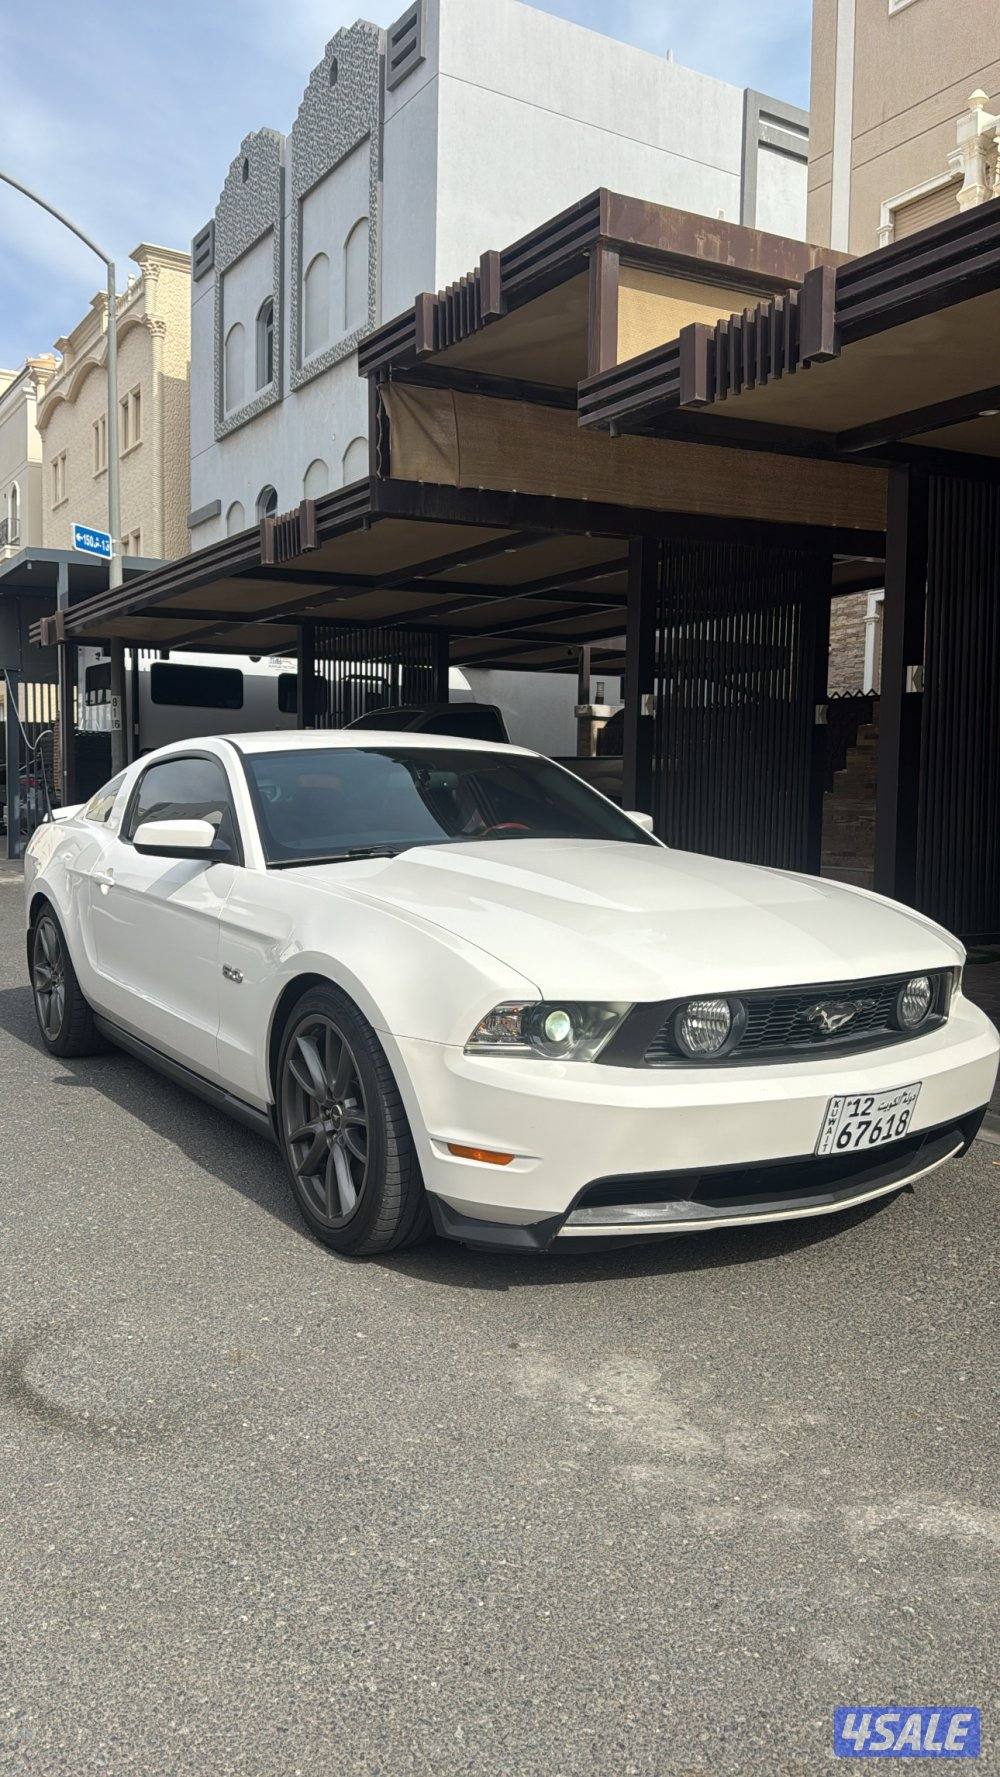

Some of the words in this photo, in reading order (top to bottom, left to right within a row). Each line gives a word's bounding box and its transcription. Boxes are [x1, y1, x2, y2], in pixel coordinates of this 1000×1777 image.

[849, 1097, 875, 1118] 12
[877, 1094, 905, 1113] الكويت
[901, 1091, 917, 1106] دولة
[823, 1099, 841, 1153] KUWAIT
[836, 1109, 910, 1149] 67618
